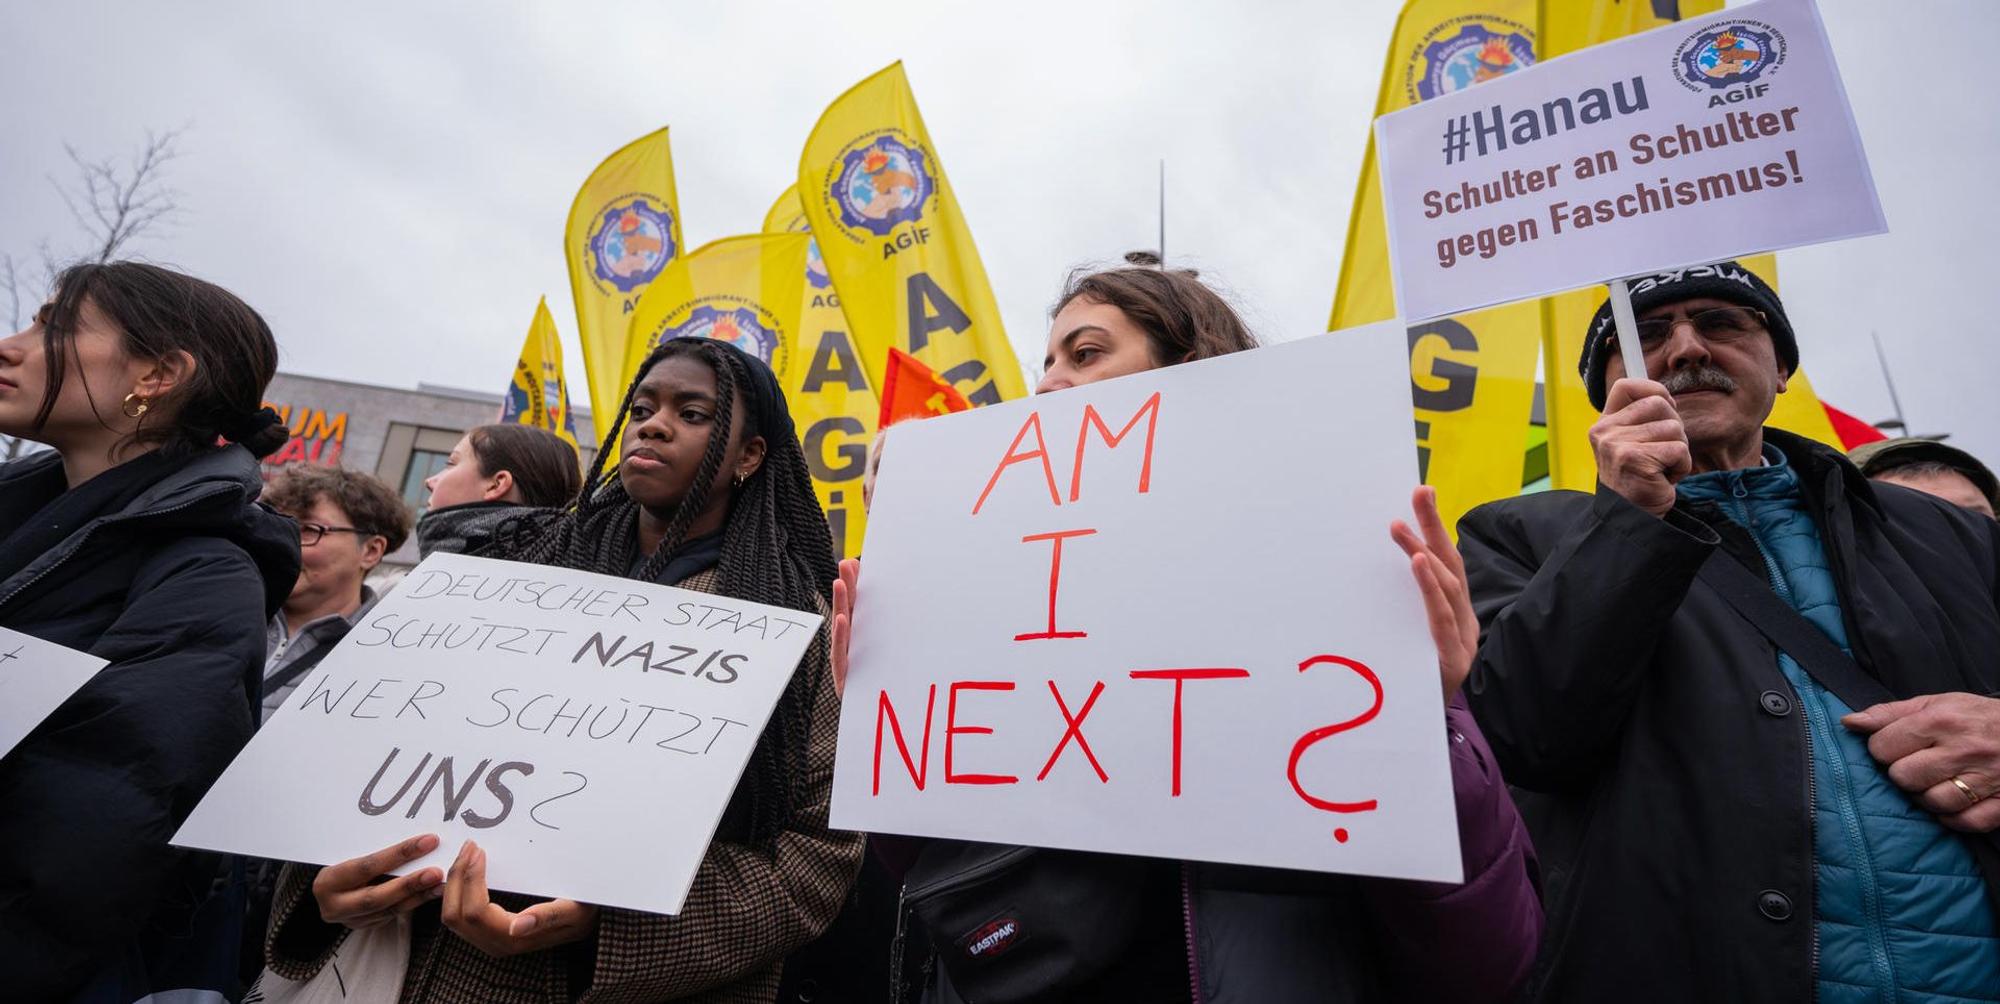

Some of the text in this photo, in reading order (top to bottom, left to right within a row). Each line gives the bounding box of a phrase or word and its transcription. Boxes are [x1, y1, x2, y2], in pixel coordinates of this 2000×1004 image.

[1423, 106, 1800, 219] Schulter an Schulter
[1442, 76, 1649, 166] #Hanau
[1437, 149, 1804, 269] gegen Faschismus!
[258, 401, 348, 443] UM
[972, 391, 1161, 515] AM
[406, 570, 809, 640] DEUTSCHER STAAT
[1014, 528, 1098, 641] I
[356, 613, 749, 684] SCHÜTZT NAZIS
[300, 674, 749, 755] WER SCHÜTZT
[970, 923, 1015, 956] EASTPAK
